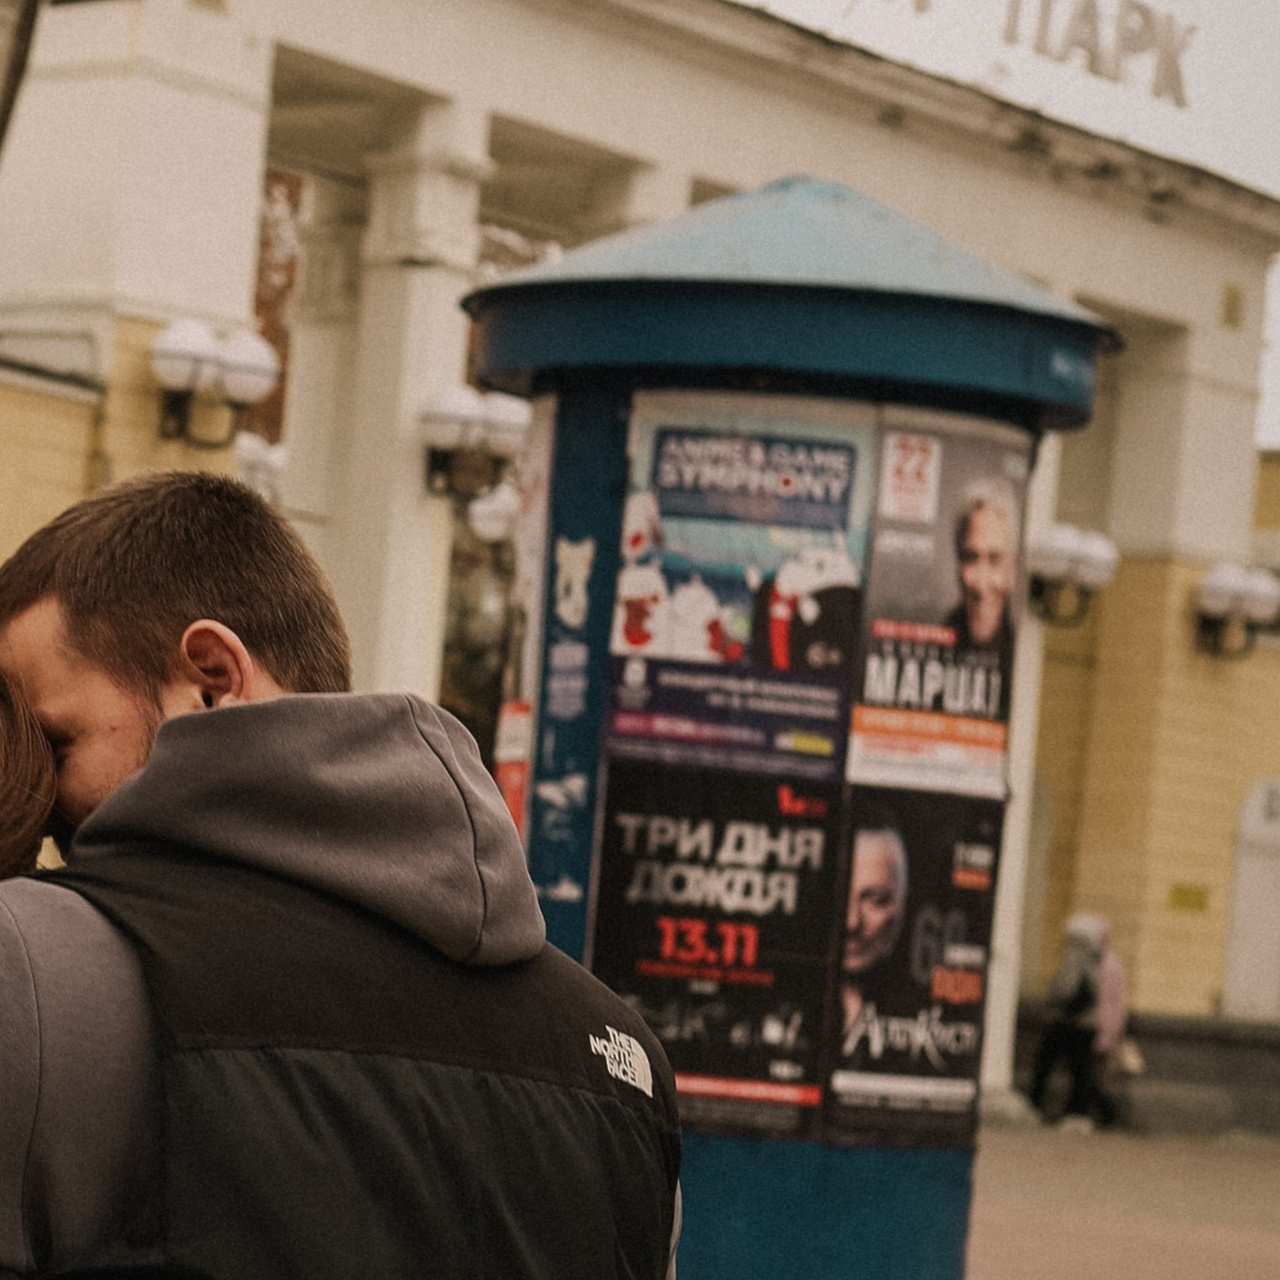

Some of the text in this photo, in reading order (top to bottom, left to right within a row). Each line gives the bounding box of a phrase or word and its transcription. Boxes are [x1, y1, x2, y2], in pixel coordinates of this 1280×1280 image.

[616, 814, 825, 870] ТРИ ДНЯ
[658, 916, 759, 967] 13.11
[588, 1033, 634, 1070] NORTH
[605, 1024, 632, 1055] THE
[606, 1054, 638, 1087] FACE
